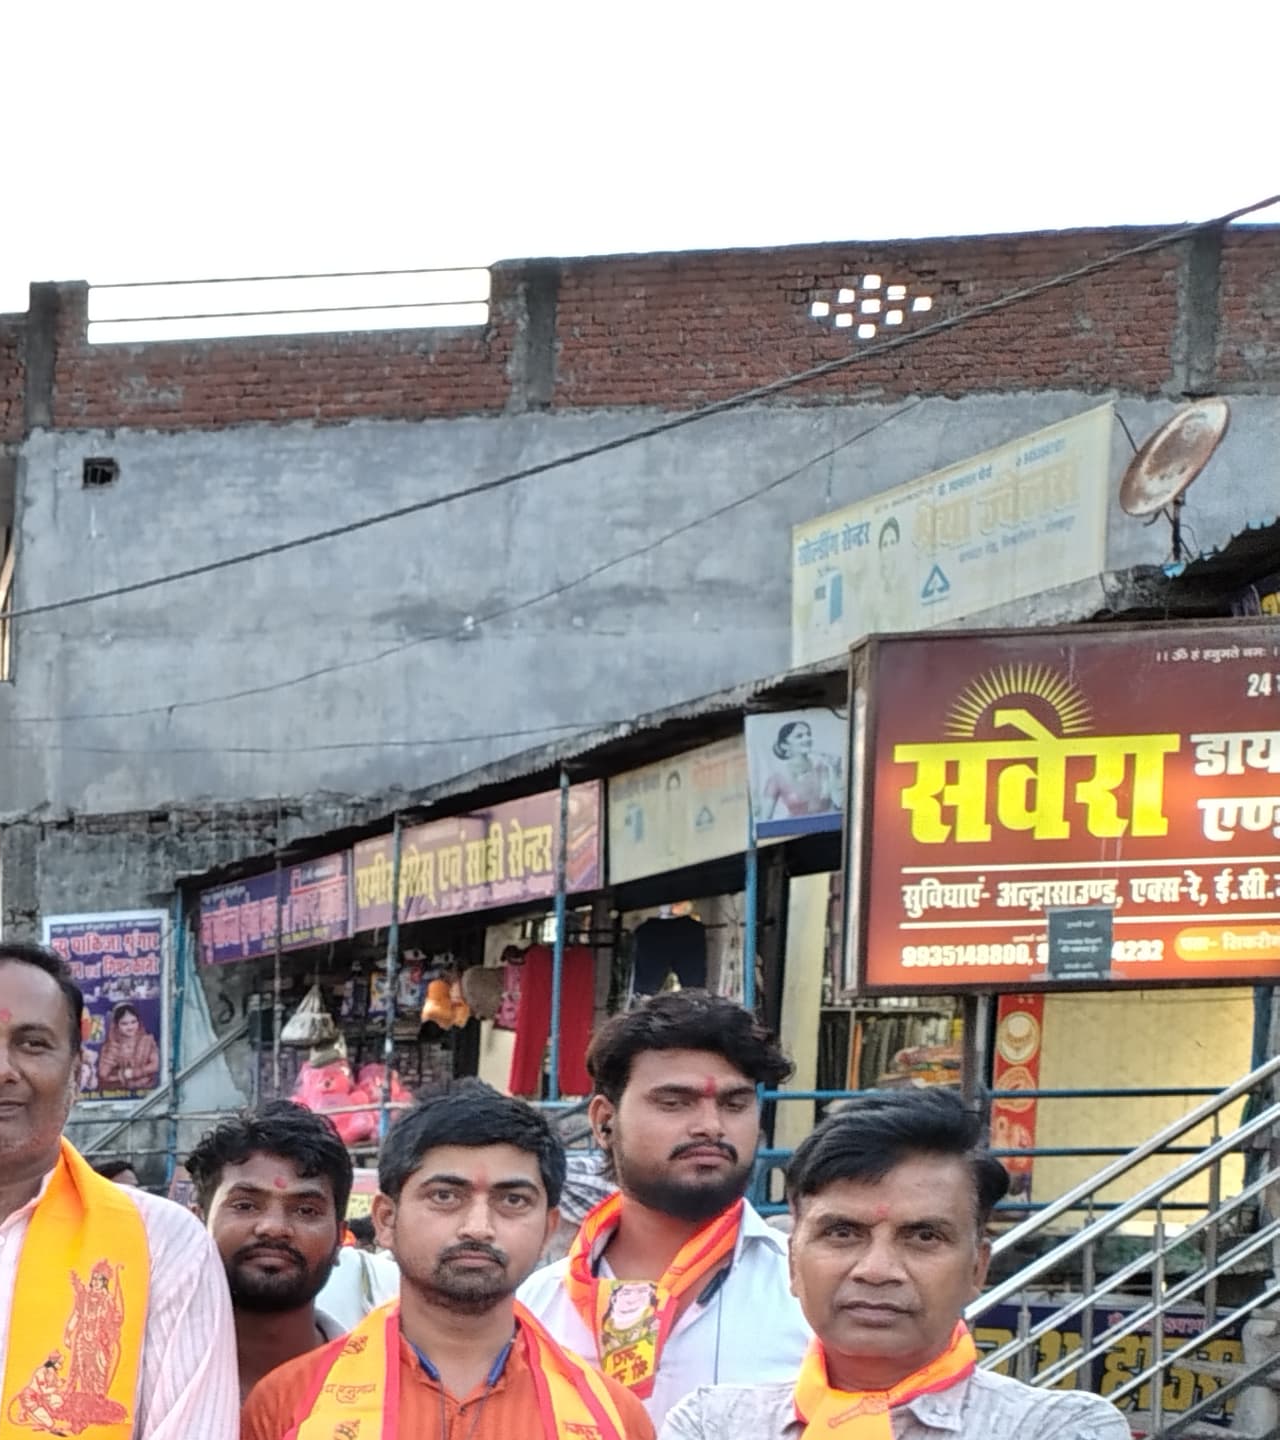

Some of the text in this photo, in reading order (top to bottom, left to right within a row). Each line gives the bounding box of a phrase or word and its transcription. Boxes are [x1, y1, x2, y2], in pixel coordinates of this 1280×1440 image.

[1247, 672, 1272, 697] 24
[892, 708, 1181, 844] सवेरा
[507, 819, 554, 879] सेन्टर
